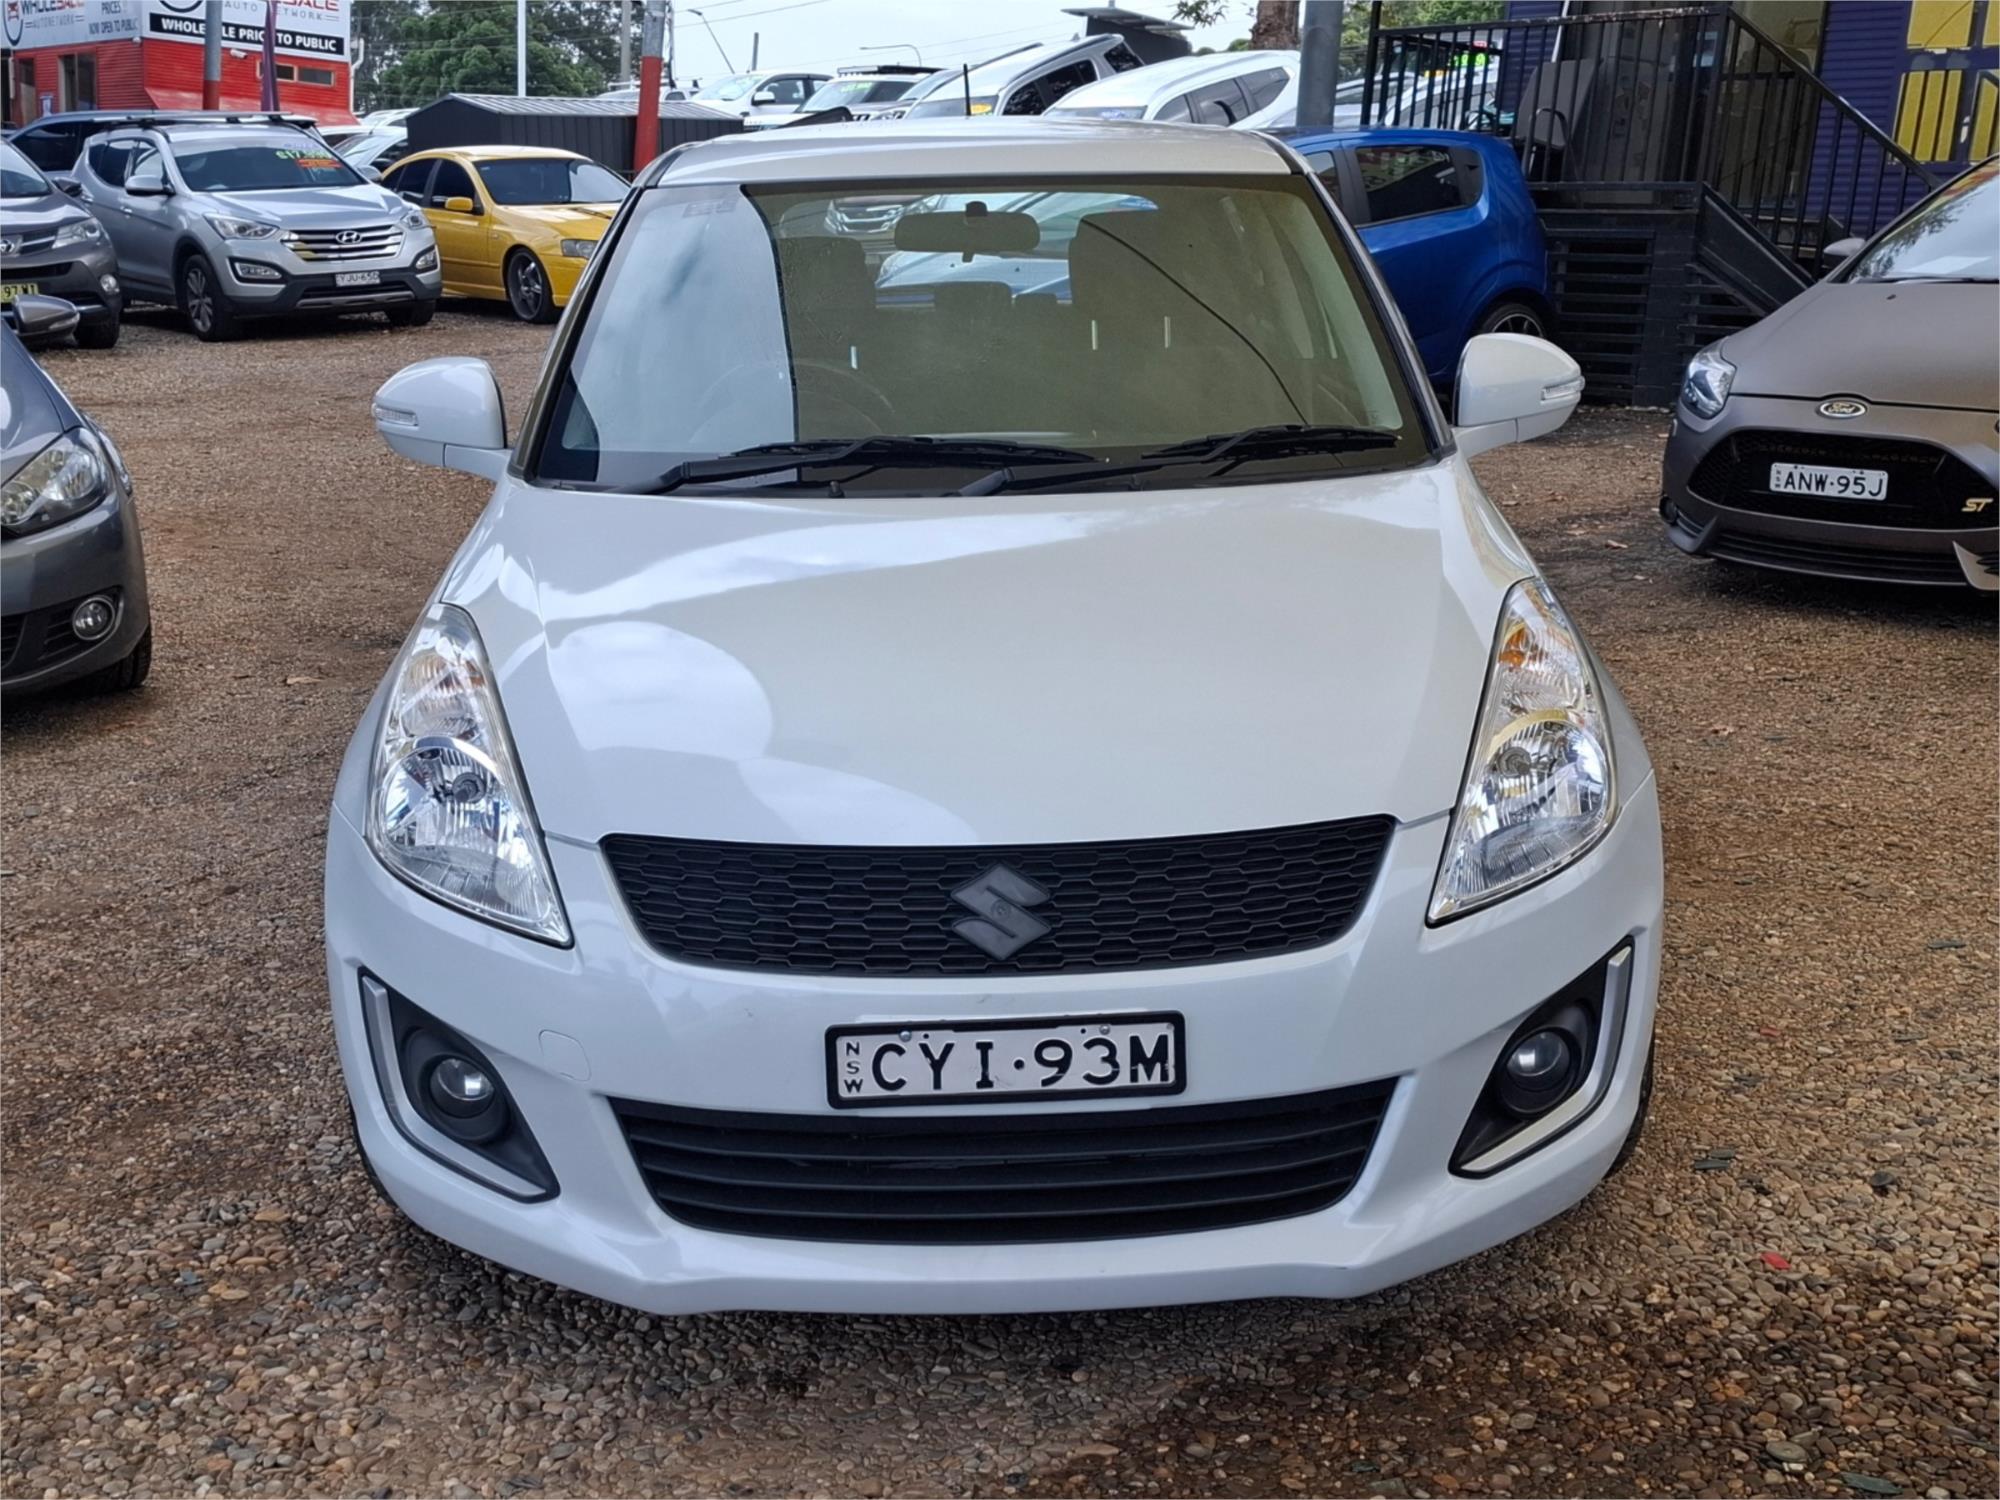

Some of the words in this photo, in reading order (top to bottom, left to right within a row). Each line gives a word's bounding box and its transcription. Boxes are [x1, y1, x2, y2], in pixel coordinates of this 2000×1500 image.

[224, 0, 258, 12] AUTO
[276, 8, 323, 21] ETWORK
[161, 17, 236, 39] WHOLELE
[239, 29, 265, 42] PRIC
[277, 32, 292, 45] TO
[295, 36, 337, 51] PUBLIC
[1961, 497, 1994, 512] ST
